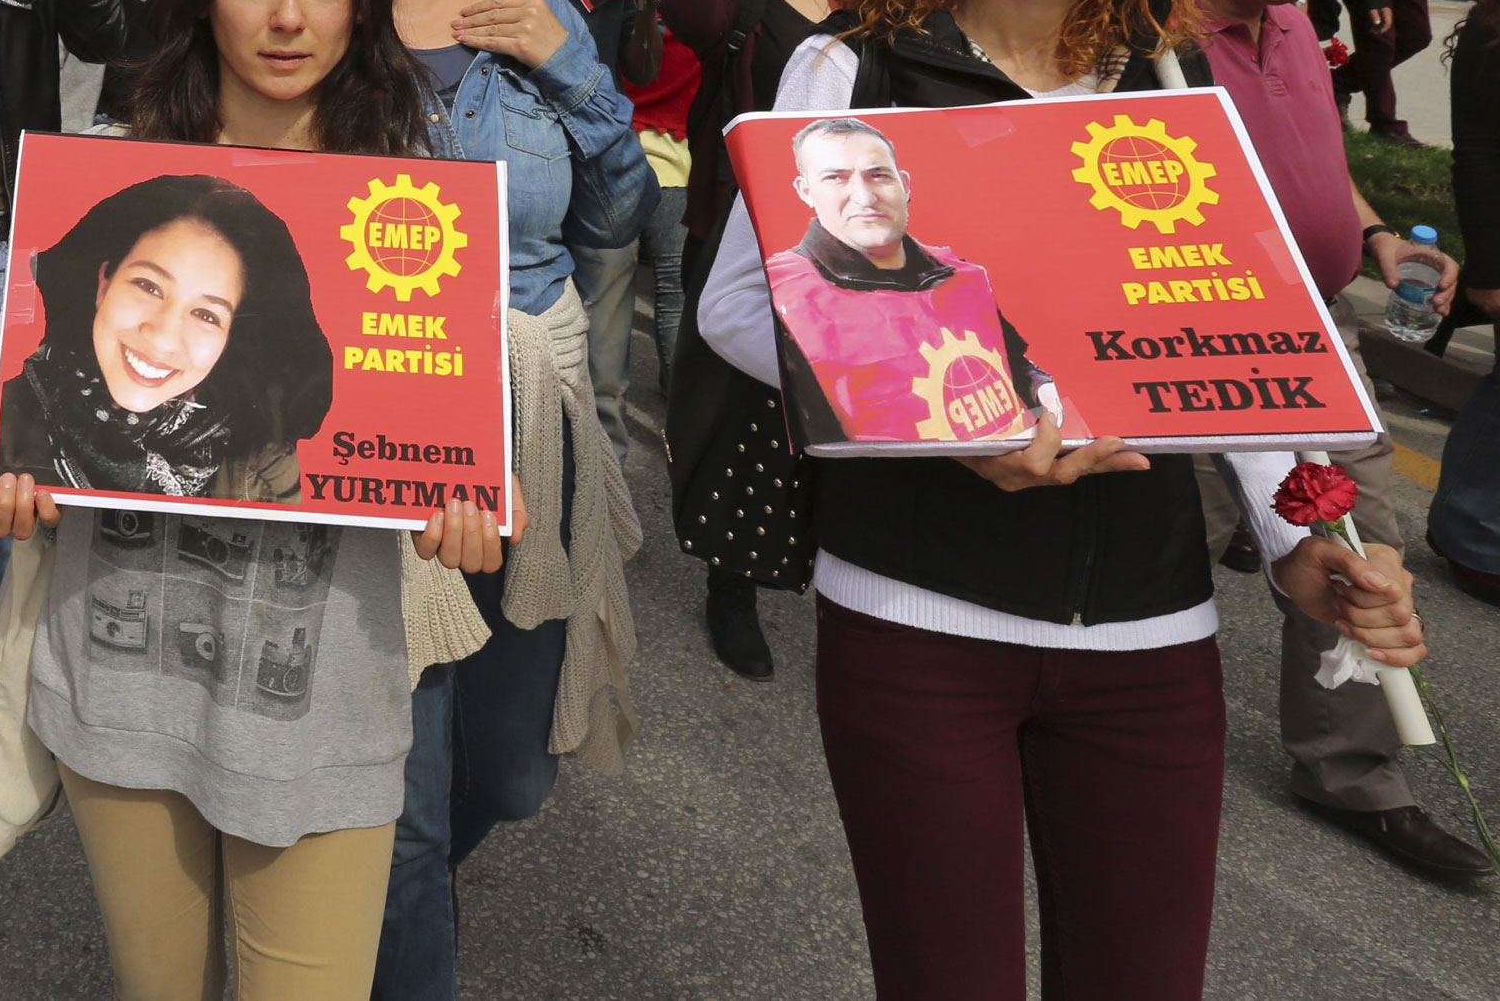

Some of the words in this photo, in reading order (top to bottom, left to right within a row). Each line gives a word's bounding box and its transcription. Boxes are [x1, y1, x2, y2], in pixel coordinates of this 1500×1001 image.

[1106, 159, 1186, 187] EMEP
[368, 221, 442, 250] EMEP
[1128, 243, 1232, 270] EMEK
[1121, 267, 1265, 305] PARTİSİ
[361, 312, 448, 340] EMEK
[1085, 326, 1328, 361] Korkmaz
[344, 345, 464, 376] PARTİSİ
[1134, 366, 1326, 414] TEDİK
[332, 430, 476, 466] Şebnem
